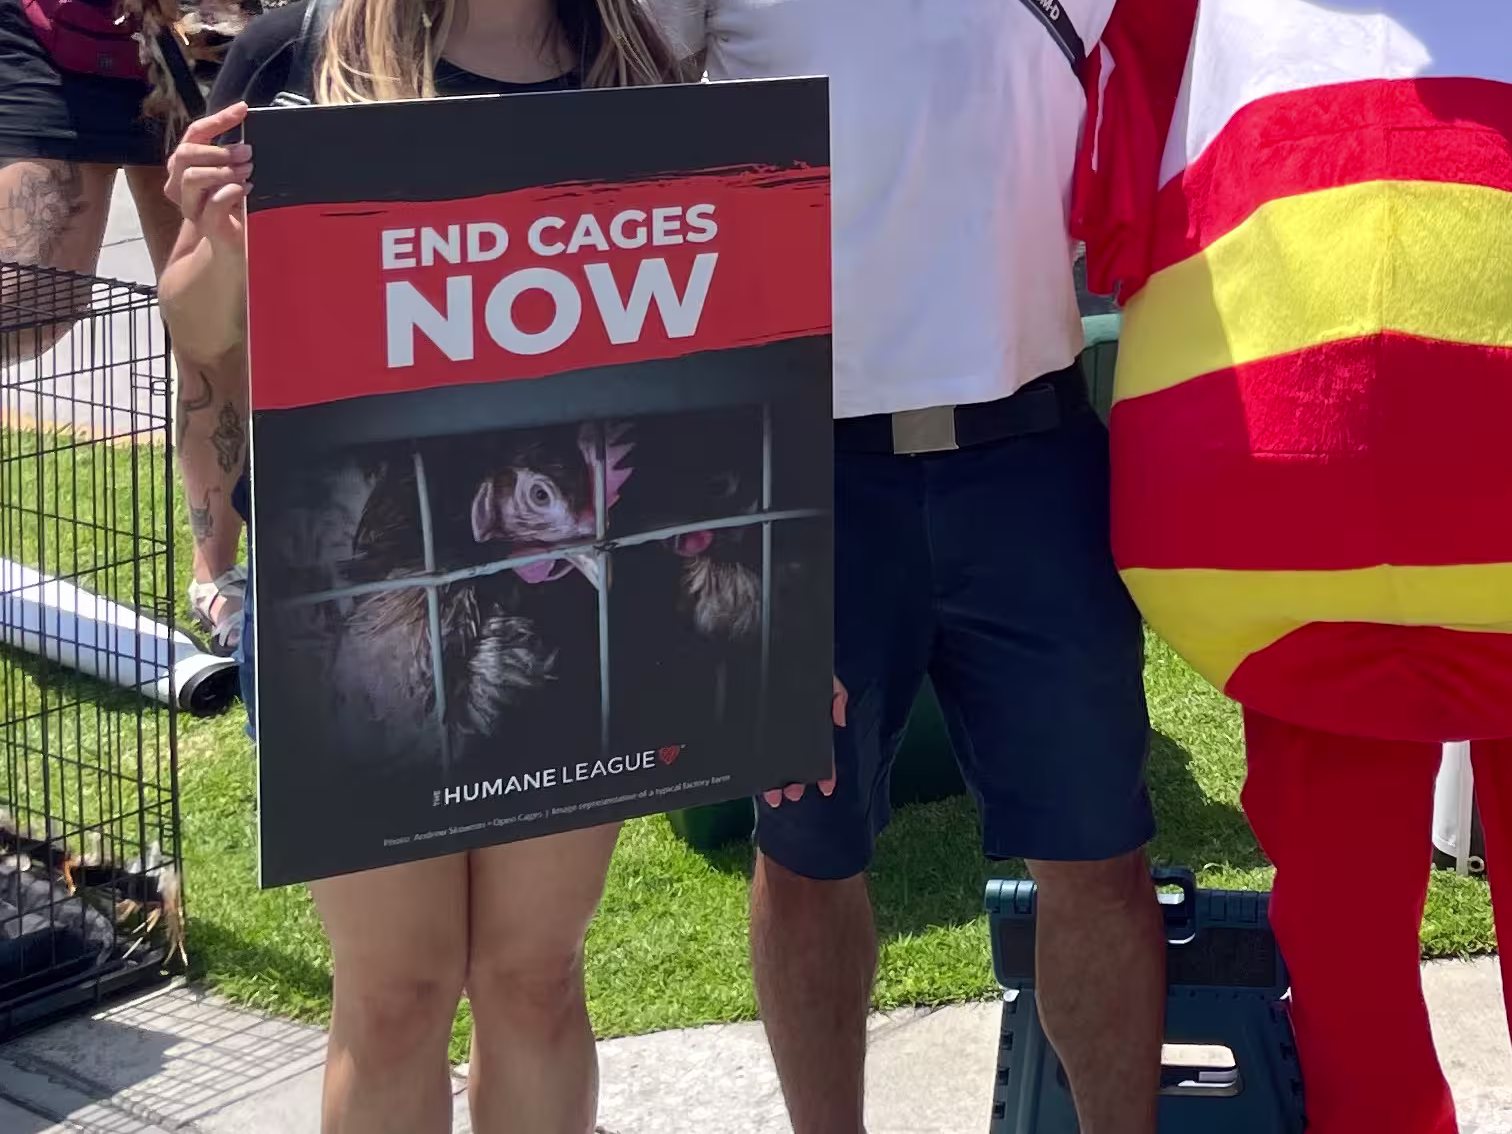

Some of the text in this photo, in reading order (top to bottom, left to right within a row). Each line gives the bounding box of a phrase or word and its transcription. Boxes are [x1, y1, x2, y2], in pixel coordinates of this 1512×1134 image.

[381, 203, 719, 270] END CAGES
[385, 253, 719, 368] NOW
[444, 768, 557, 805] HUMANE
[562, 750, 656, 784] LEAGUE
